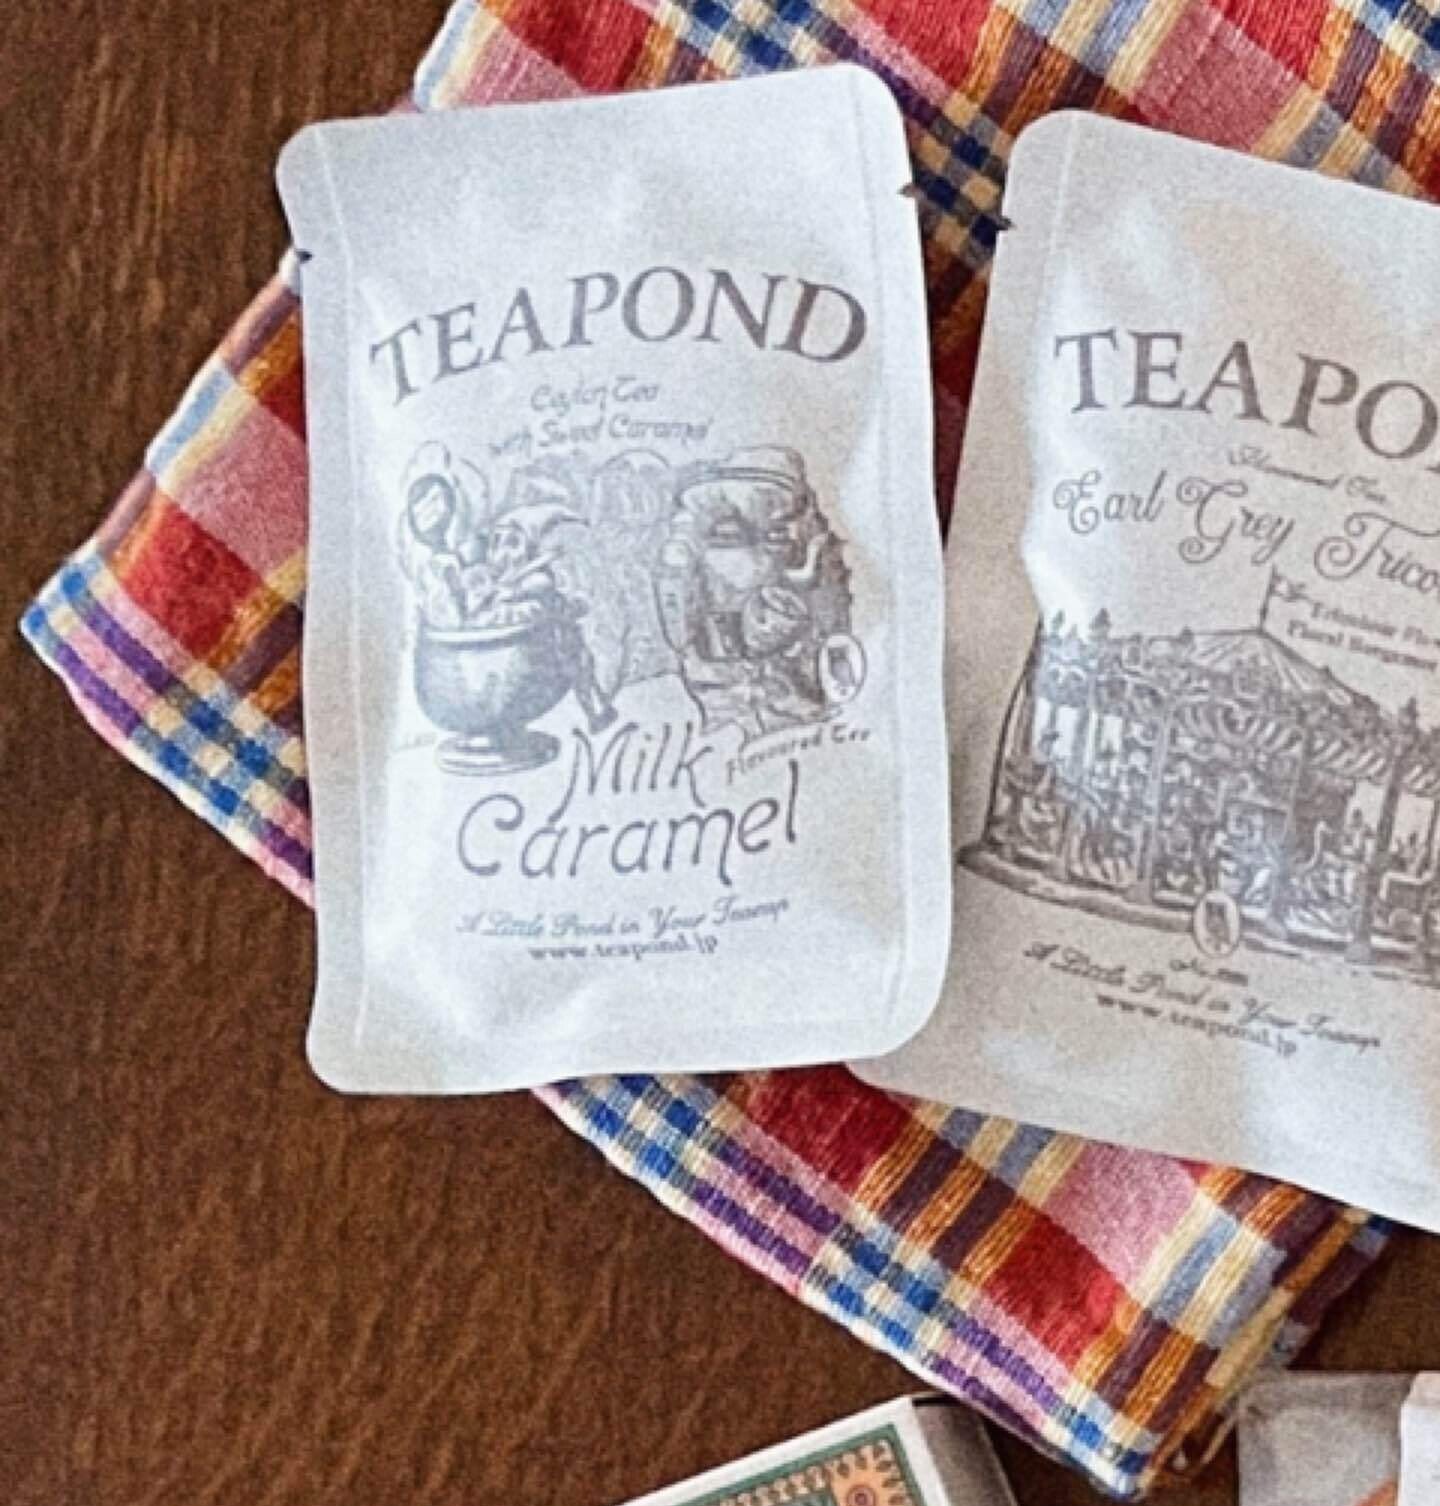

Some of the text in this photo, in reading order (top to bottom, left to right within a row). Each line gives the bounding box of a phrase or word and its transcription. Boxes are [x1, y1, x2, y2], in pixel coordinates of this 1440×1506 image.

[368, 265, 868, 407] TEAPOND
[1052, 469, 1167, 536] Earl
[1175, 475, 1296, 566] Grey
[456, 758, 799, 888] Caramel
[547, 719, 715, 823] Milk
